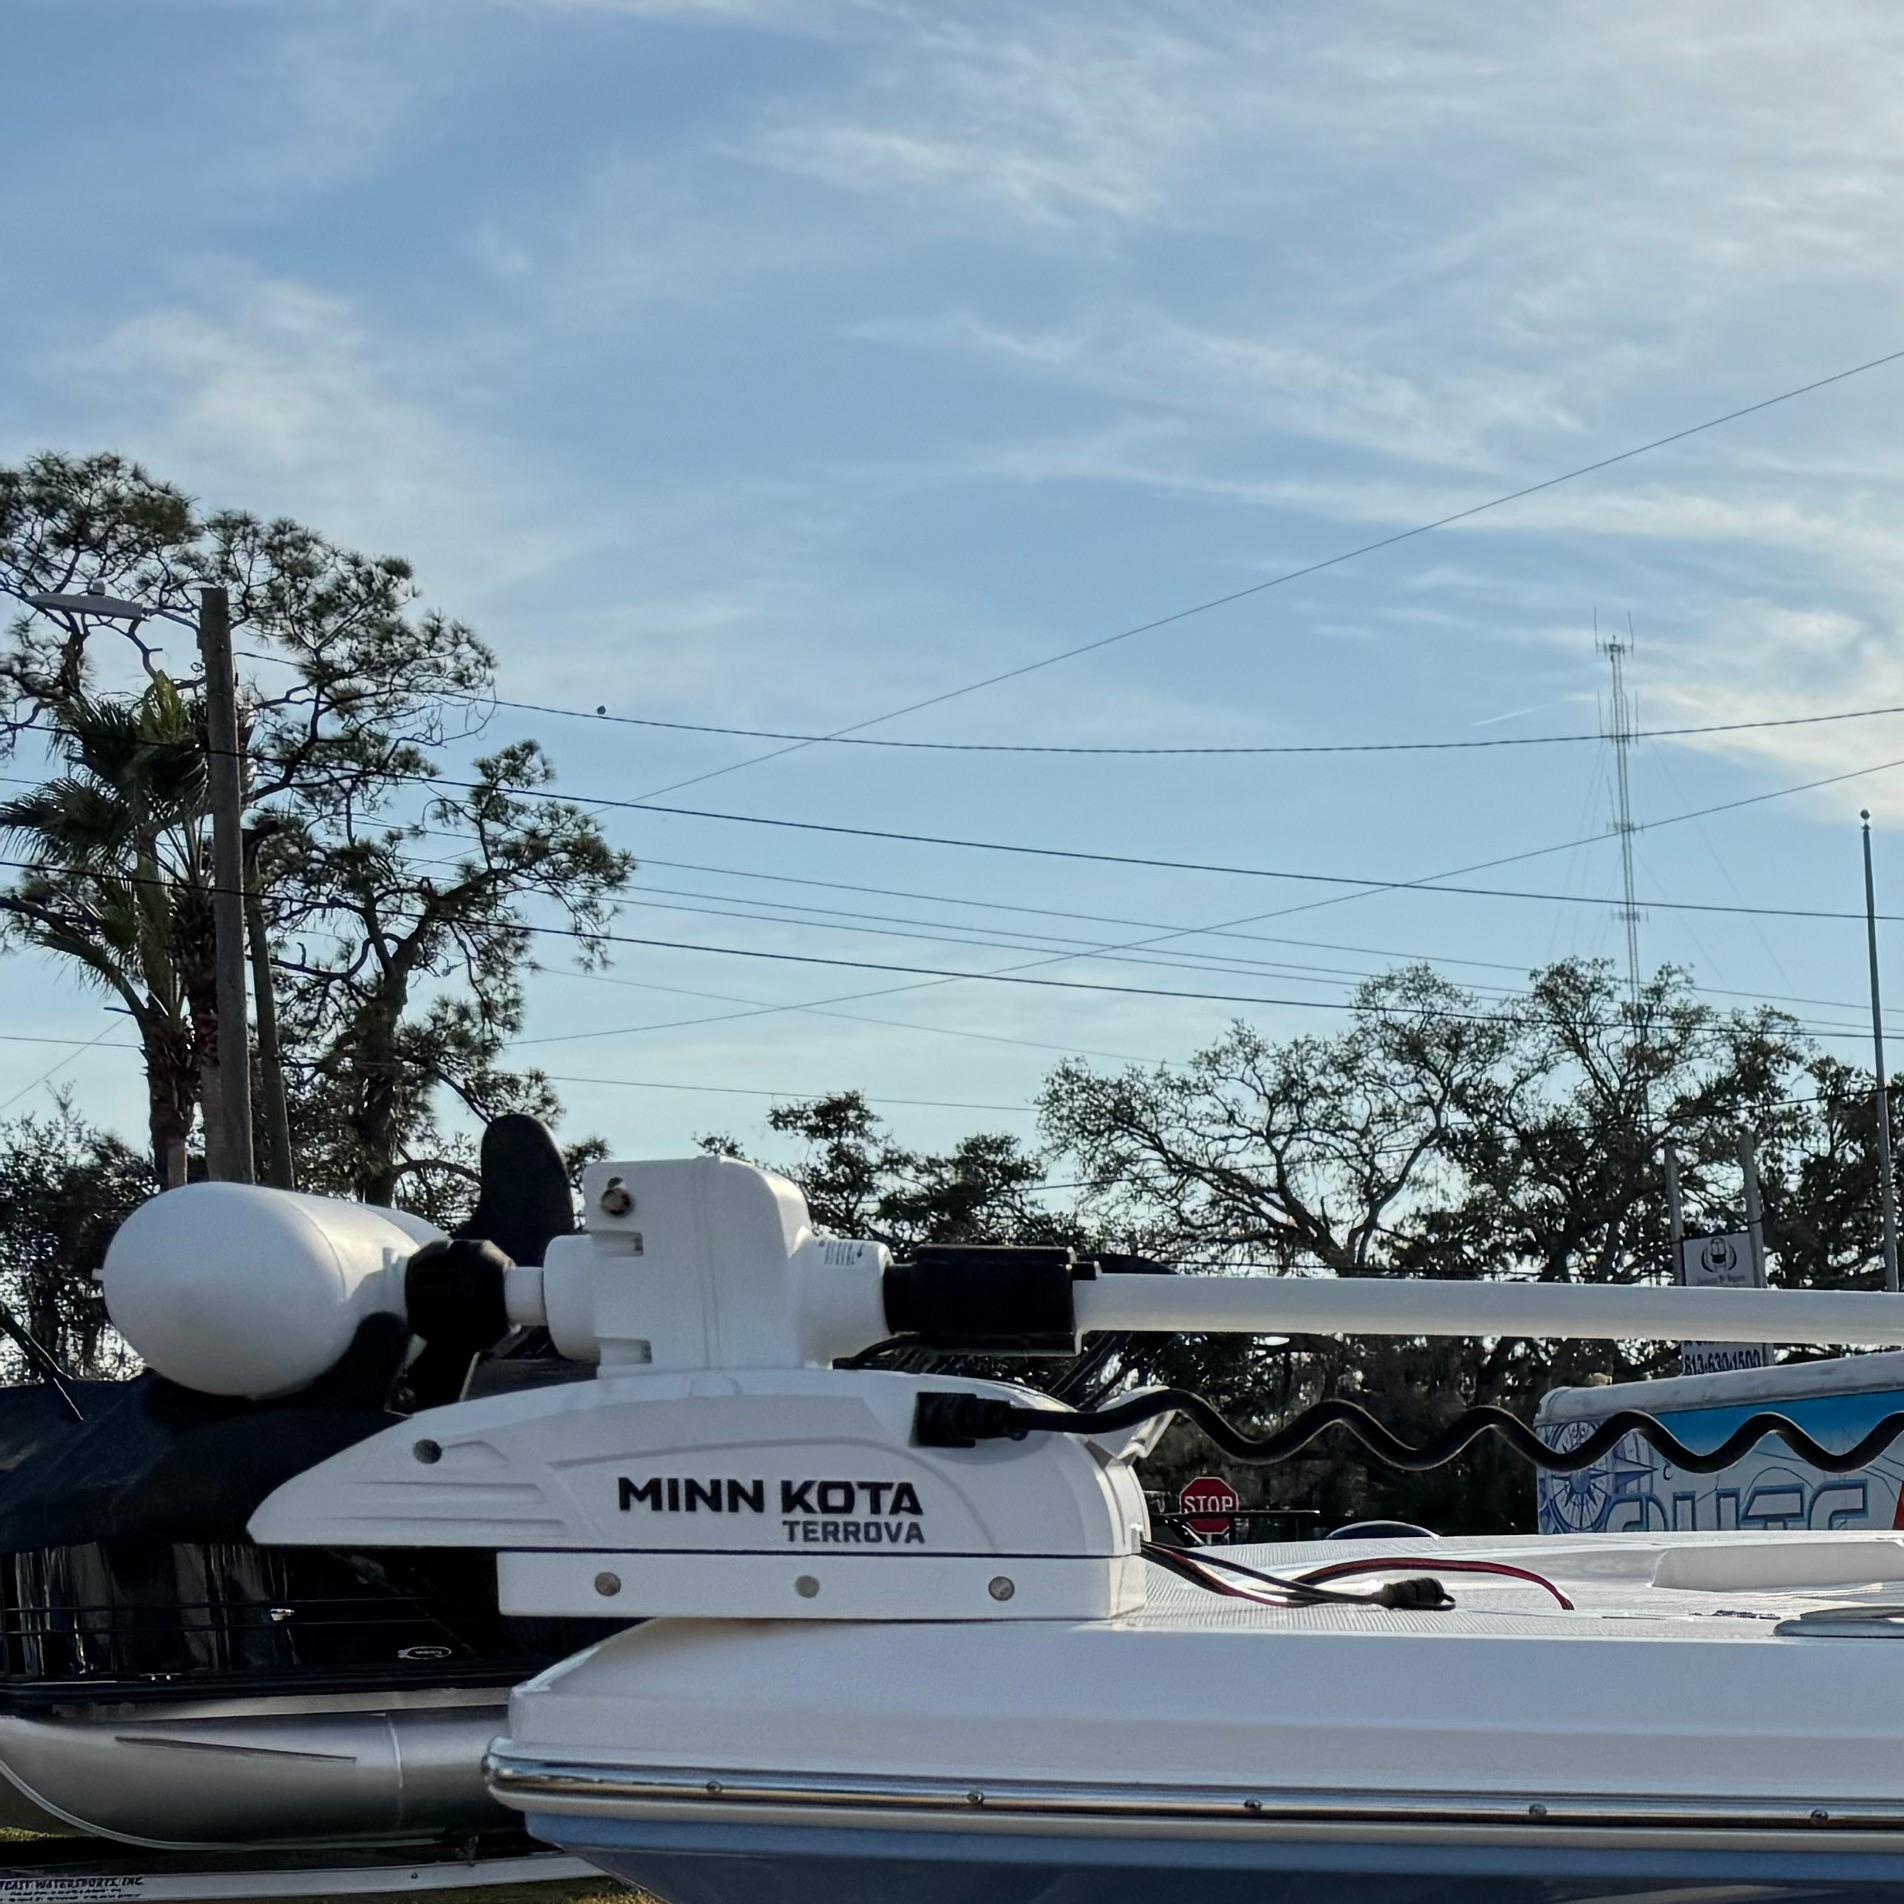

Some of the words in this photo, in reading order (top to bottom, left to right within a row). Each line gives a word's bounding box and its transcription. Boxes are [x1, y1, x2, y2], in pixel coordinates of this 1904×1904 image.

[618, 1477, 764, 1513] MINN
[781, 1480, 924, 1516] KOTA
[1184, 1495, 1233, 1514] STOP
[782, 1520, 925, 1544] TERROVA
